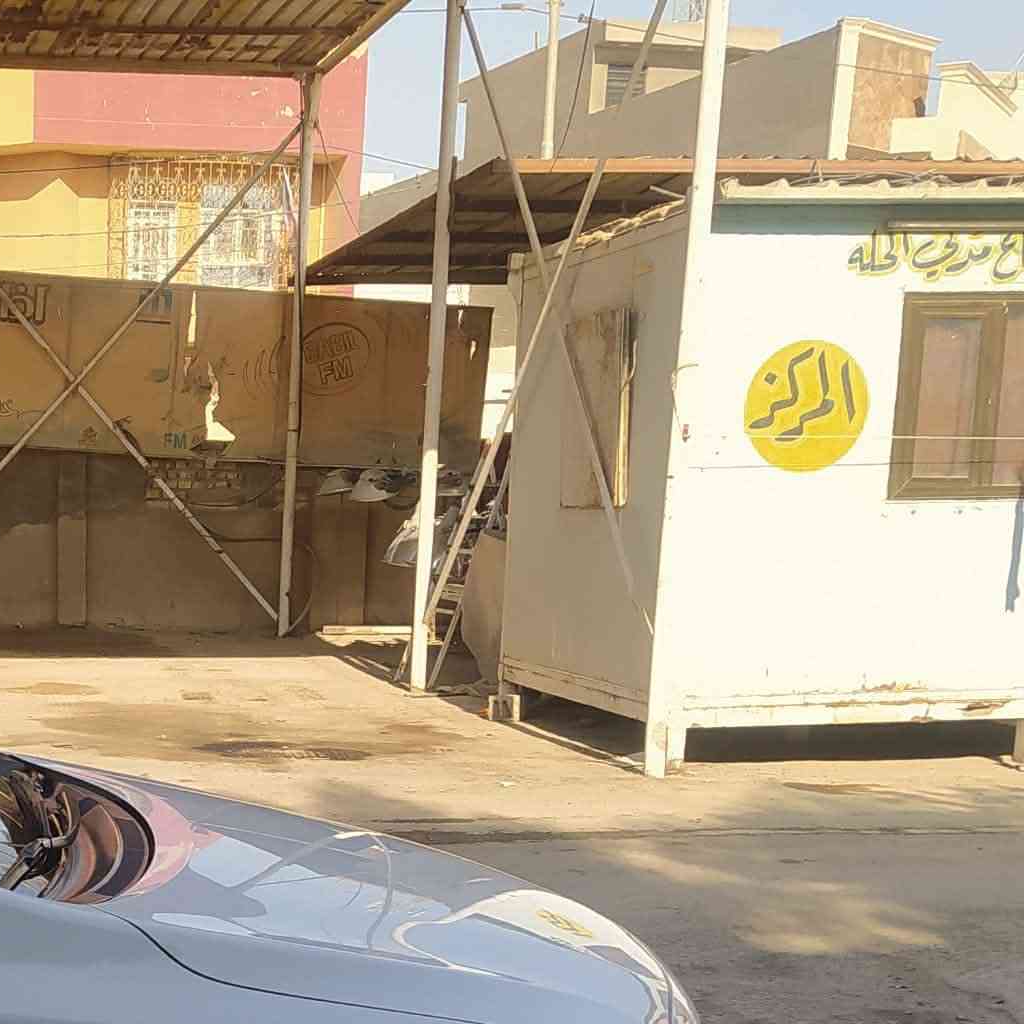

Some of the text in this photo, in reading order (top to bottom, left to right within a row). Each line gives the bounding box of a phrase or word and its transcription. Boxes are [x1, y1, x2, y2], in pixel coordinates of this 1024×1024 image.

[318, 355, 355, 385] FM
[748, 346, 856, 442] المركز
[163, 432, 188, 450] FM
